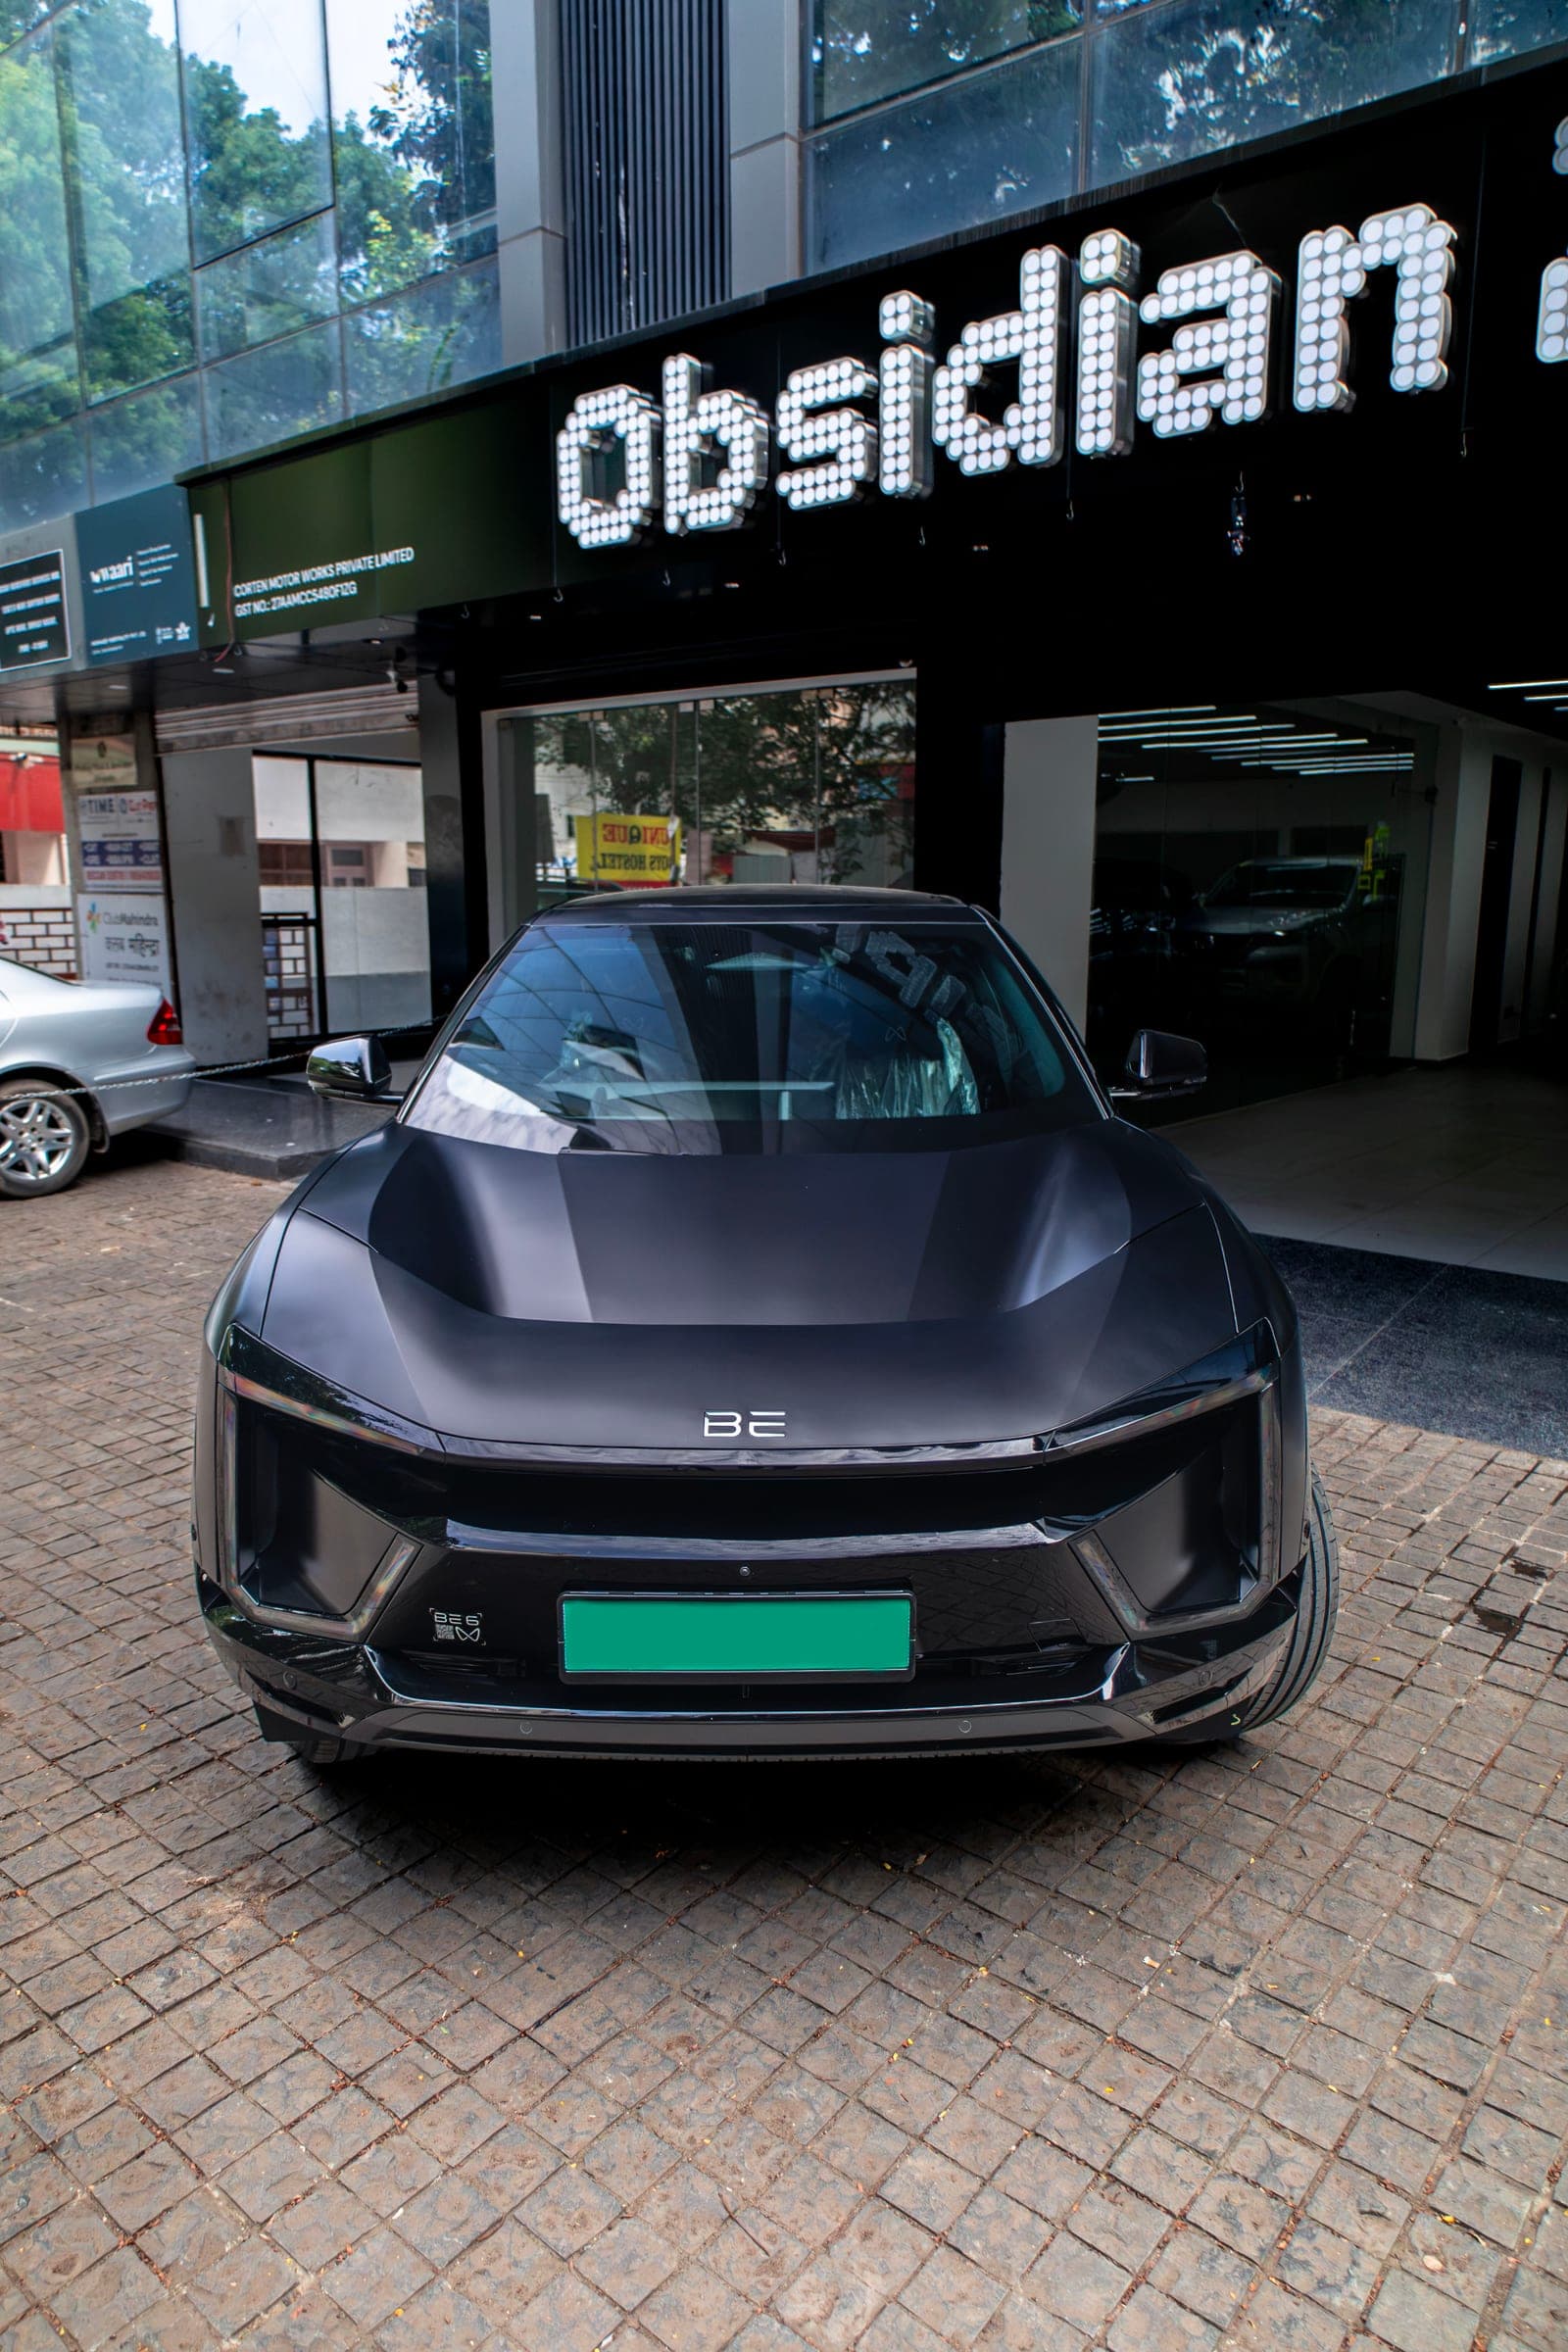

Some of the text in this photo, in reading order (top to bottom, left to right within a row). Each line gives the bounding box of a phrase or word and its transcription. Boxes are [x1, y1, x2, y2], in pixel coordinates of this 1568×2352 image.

[556, 201, 1457, 550] obsidian
[233, 546, 416, 598] CORTEN MOTOR WORKS PRIVATE LIMITED
[234, 602, 252, 617] GST
[704, 1411, 786, 1438] BE
[434, 1612, 479, 1626] BE 6
